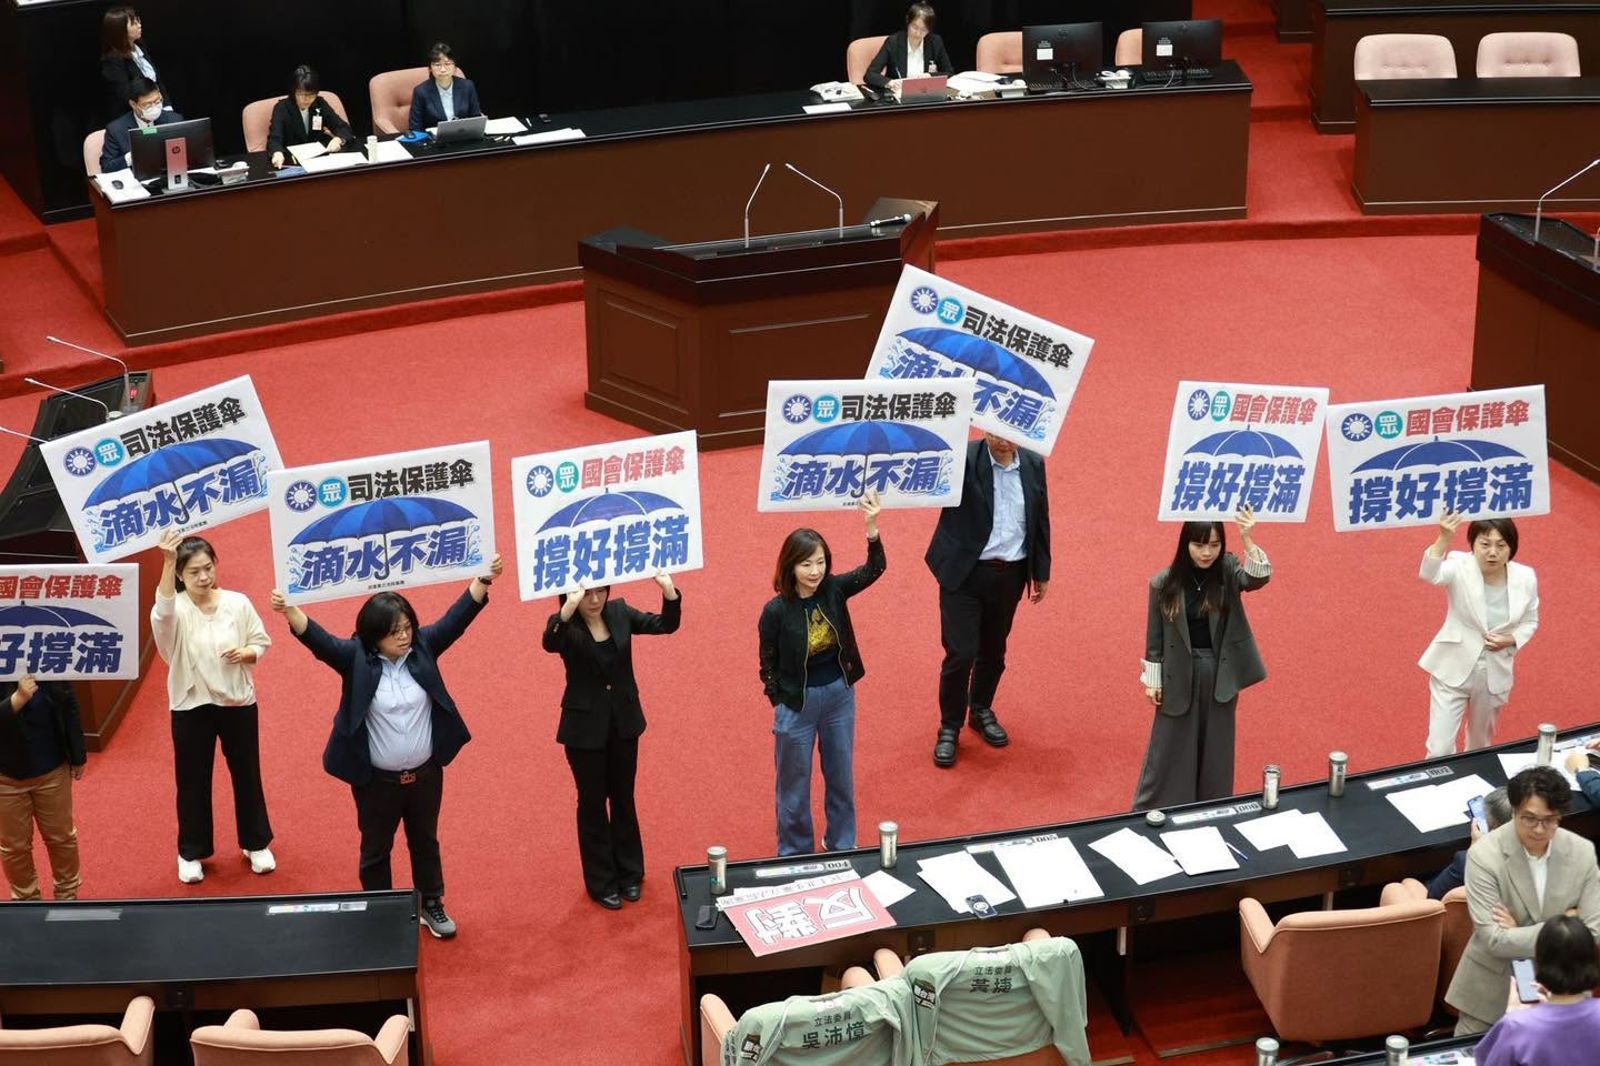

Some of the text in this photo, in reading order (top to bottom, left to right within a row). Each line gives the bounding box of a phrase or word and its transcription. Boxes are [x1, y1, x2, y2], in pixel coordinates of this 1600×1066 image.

[962, 305, 1074, 369] 司法保護傘
[840, 391, 956, 421] 司法保護傘
[890, 347, 1044, 430] 滴不漏
[1230, 393, 1318, 425] 國會保護傘
[120, 396, 246, 458] 司法保護傘
[1406, 399, 1530, 437] 國會保護傘
[348, 458, 474, 502] 司法保護傘
[581, 445, 685, 489] 國會保護傘
[781, 455, 941, 498] 滴水不漏
[1171, 460, 1306, 514] 撐好撐滿
[101, 459, 260, 546] 滴水不漏
[1349, 462, 1533, 525] 撐好撐滿
[300, 525, 468, 588] 滴水不漏
[533, 514, 690, 593] 撐好撐滿
[0, 574, 124, 599] 國會保護傘
[802, 1021, 866, 1049] 吳沛憶
